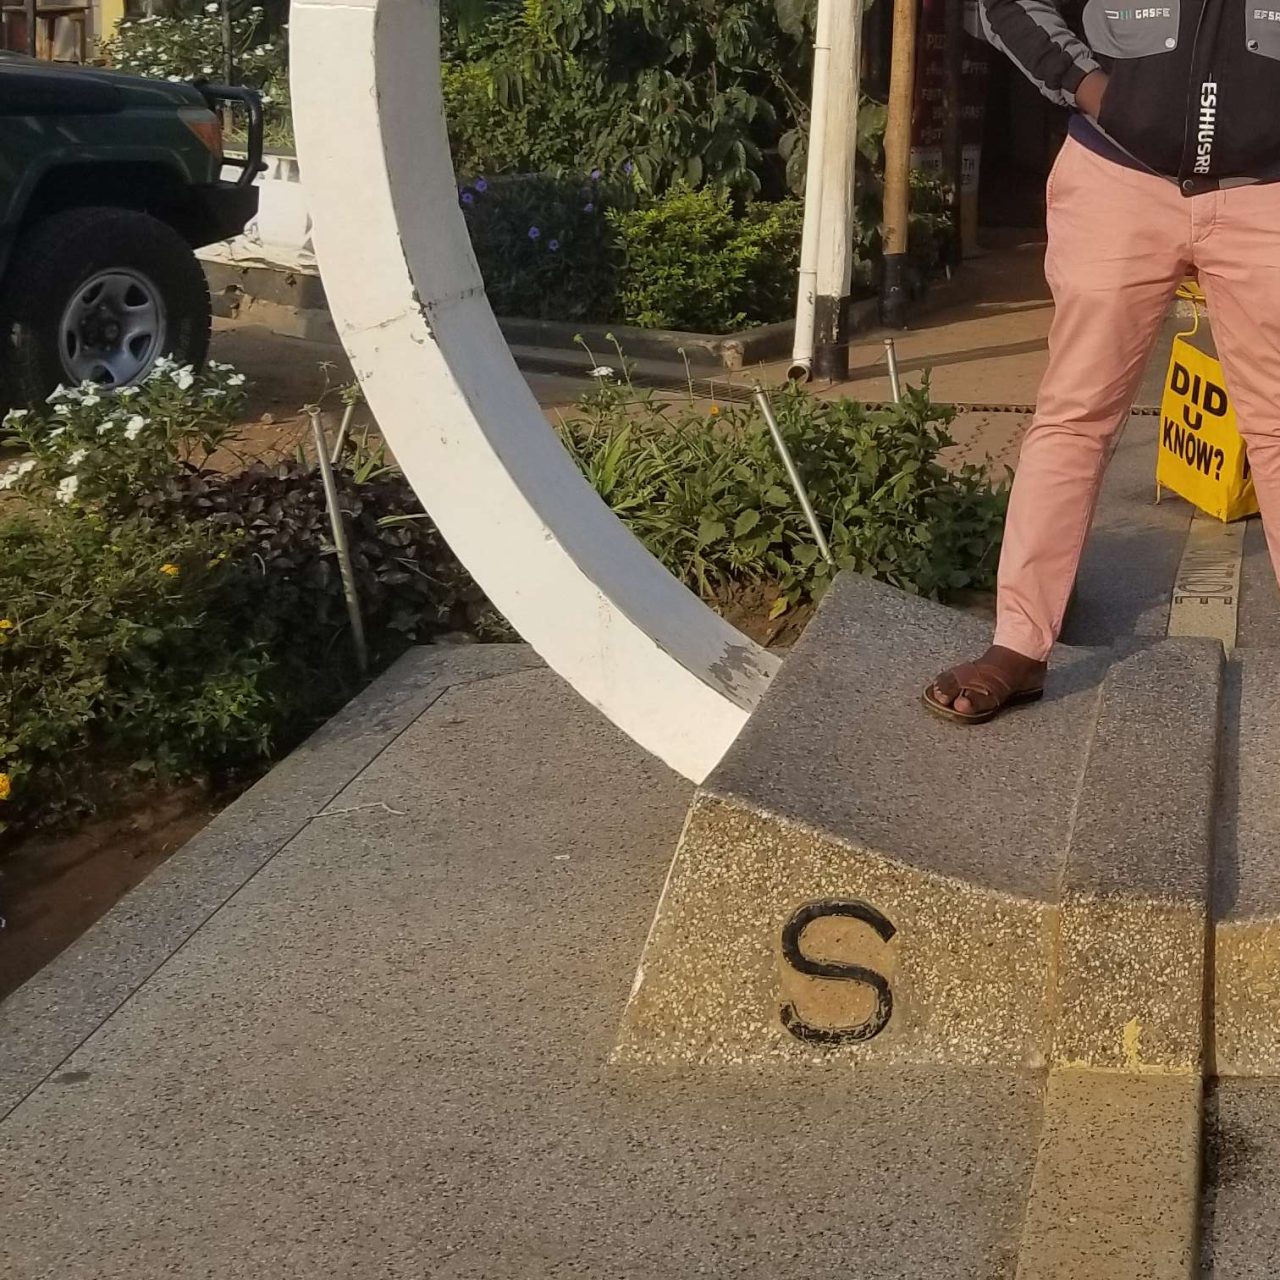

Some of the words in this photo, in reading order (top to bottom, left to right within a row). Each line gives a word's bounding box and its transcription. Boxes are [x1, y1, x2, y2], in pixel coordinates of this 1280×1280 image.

[1170, 361, 1228, 417] DID
[1183, 404, 1203, 431] U
[1162, 416, 1225, 481] KNOW?
[780, 898, 897, 1047] S
